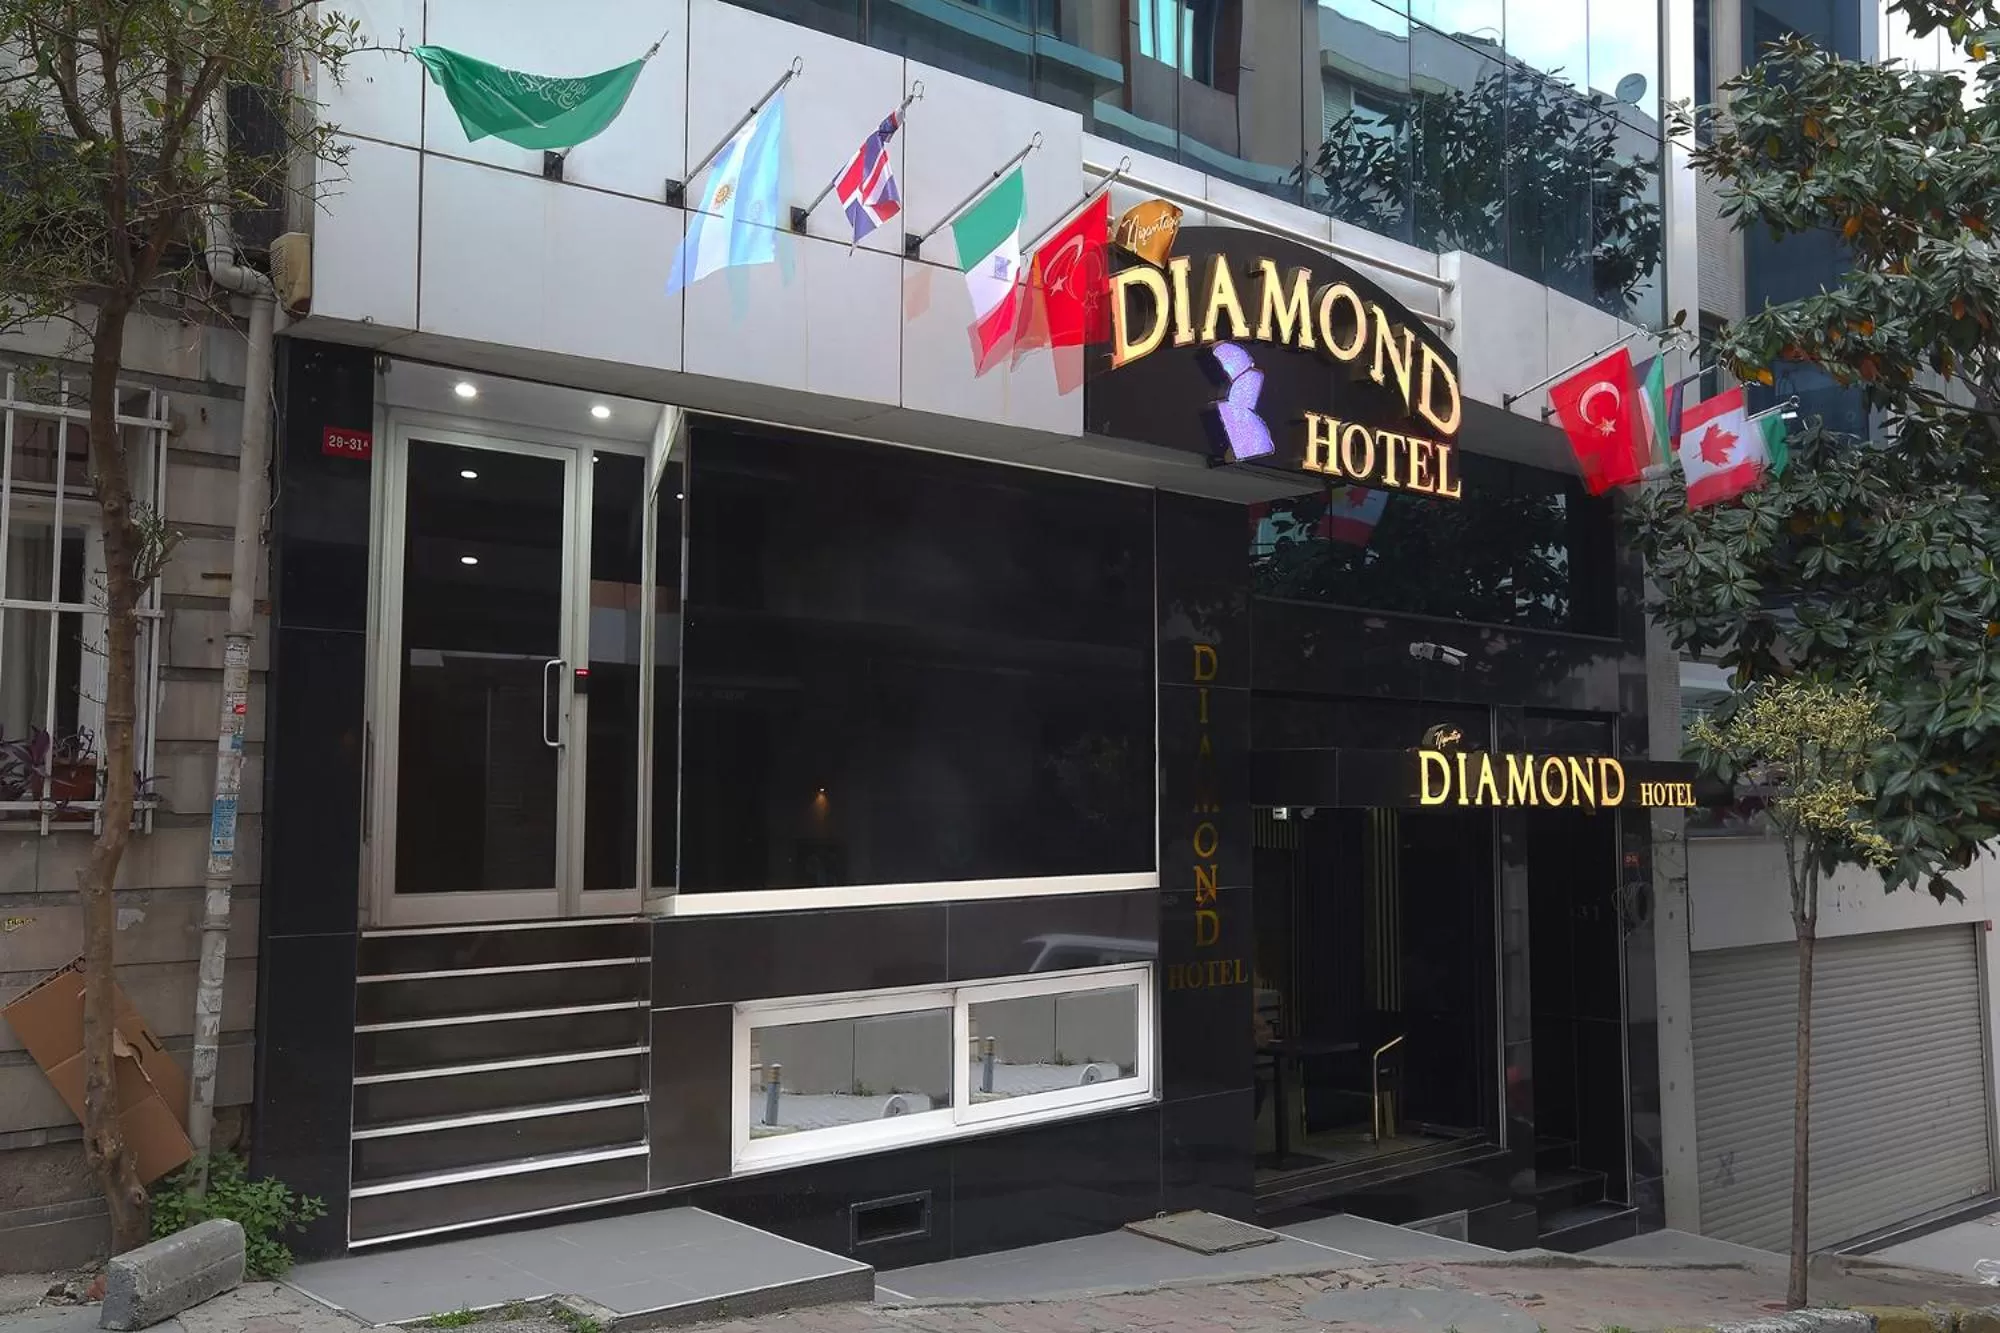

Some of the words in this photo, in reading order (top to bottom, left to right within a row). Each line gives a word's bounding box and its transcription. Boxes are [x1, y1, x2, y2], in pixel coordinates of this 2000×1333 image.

[1110, 252, 1462, 437] DIAMOND
[1302, 411, 1462, 498] HOTEL
[1192, 644, 1221, 947] DIAOND
[1418, 750, 1625, 808] DIAMOND
[1640, 782, 1696, 807] HOTEL
[1168, 959, 1249, 991] HOTEL
